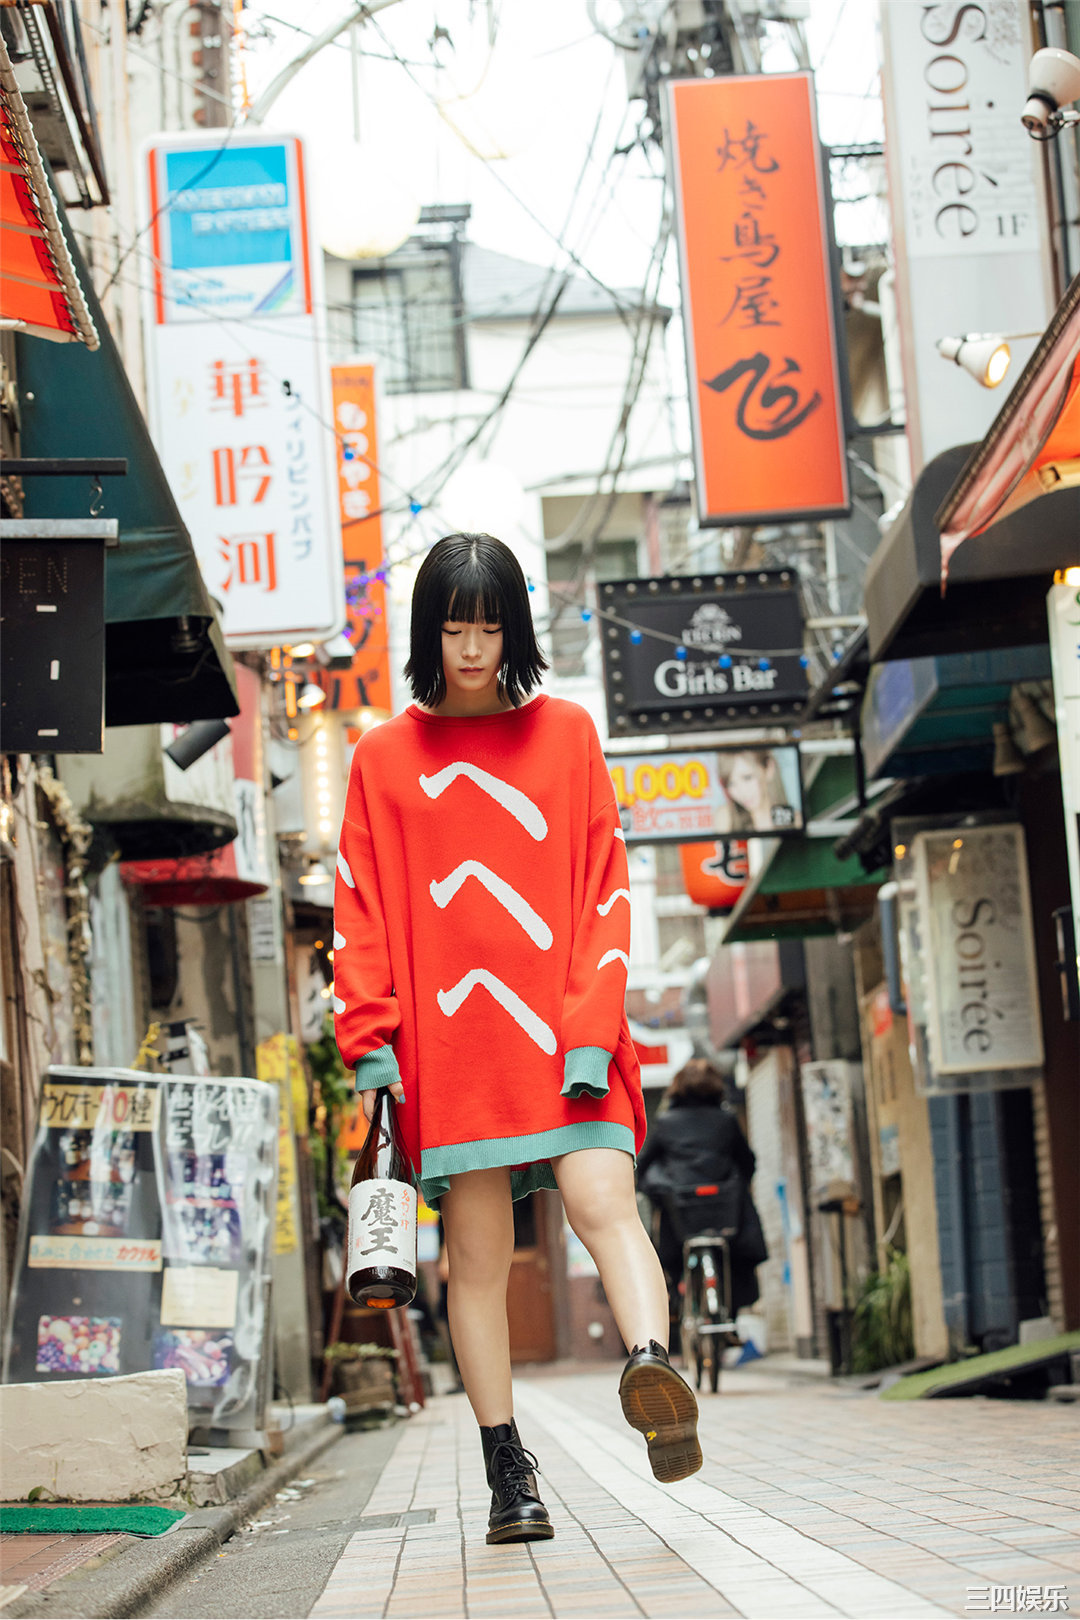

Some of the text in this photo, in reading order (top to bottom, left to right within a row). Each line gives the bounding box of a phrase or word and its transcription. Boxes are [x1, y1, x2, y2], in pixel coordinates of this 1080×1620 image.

[920, 4, 998, 239] Soirée
[715, 119, 783, 329] 焼き鳥屋
[208, 357, 277, 593] 華吟河
[654, 659, 779, 698] Girls Bar
[610, 761, 710, 808] 1,000
[951, 898, 1005, 1054] Soirée
[360, 1187, 398, 1256] 魔王
